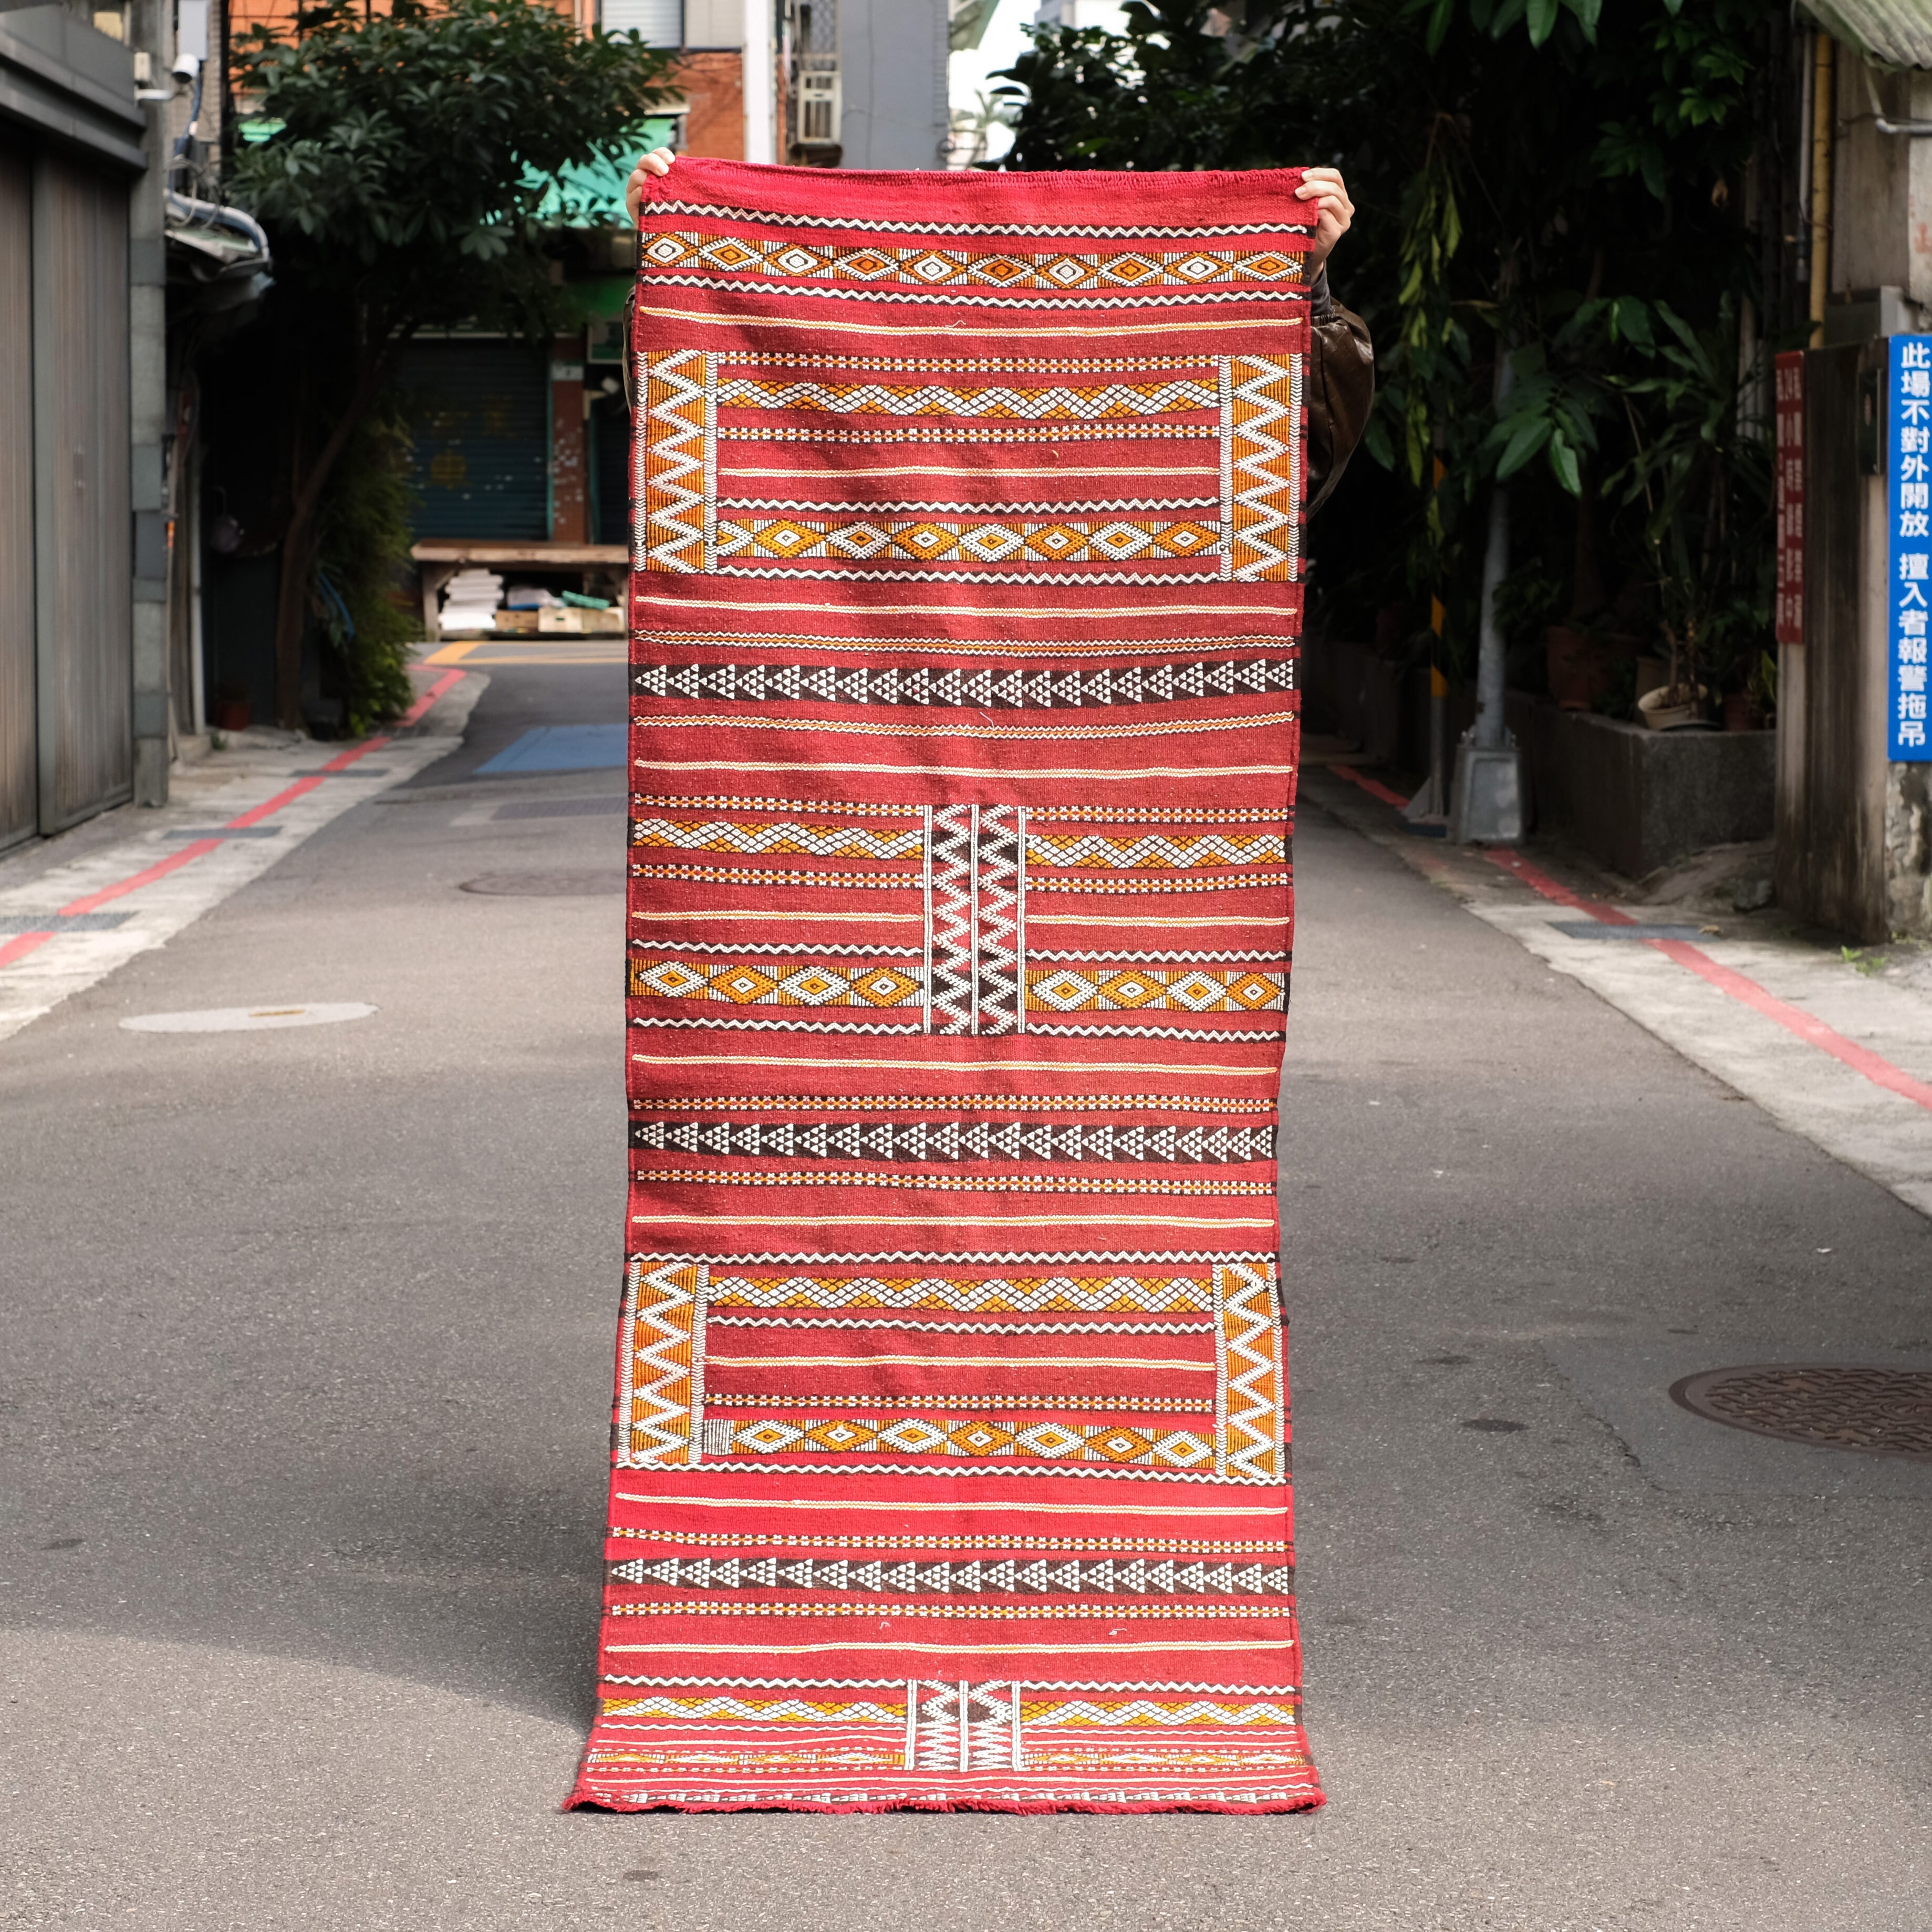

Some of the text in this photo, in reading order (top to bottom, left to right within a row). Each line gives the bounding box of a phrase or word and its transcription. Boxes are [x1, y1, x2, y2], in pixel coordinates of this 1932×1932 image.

[1898, 342, 1930, 746] 此場不對外開放 擅入者報警拖吊
